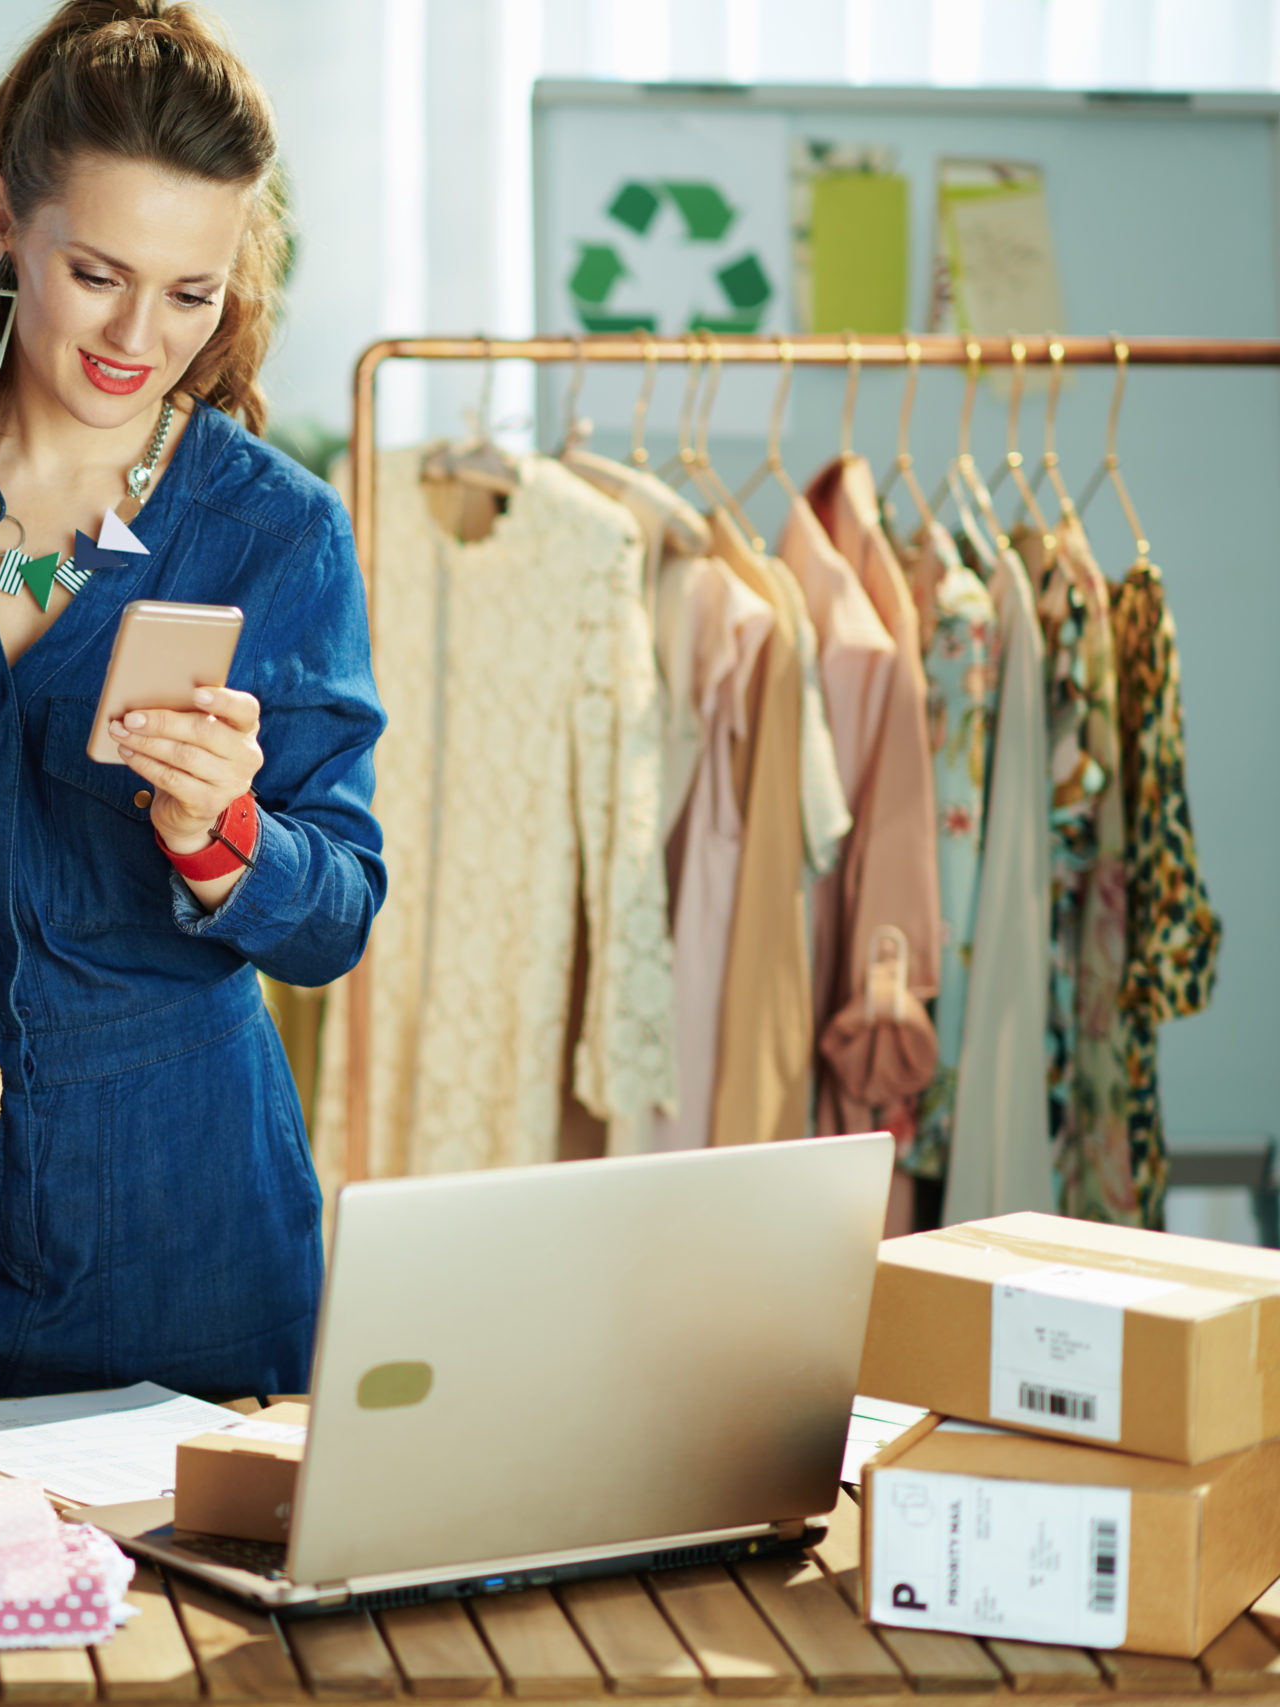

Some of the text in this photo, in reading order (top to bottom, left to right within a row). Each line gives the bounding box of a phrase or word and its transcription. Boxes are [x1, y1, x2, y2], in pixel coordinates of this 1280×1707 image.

[948, 1499, 962, 1606] PRIORITY MAIL
[892, 1583, 927, 1612] P
